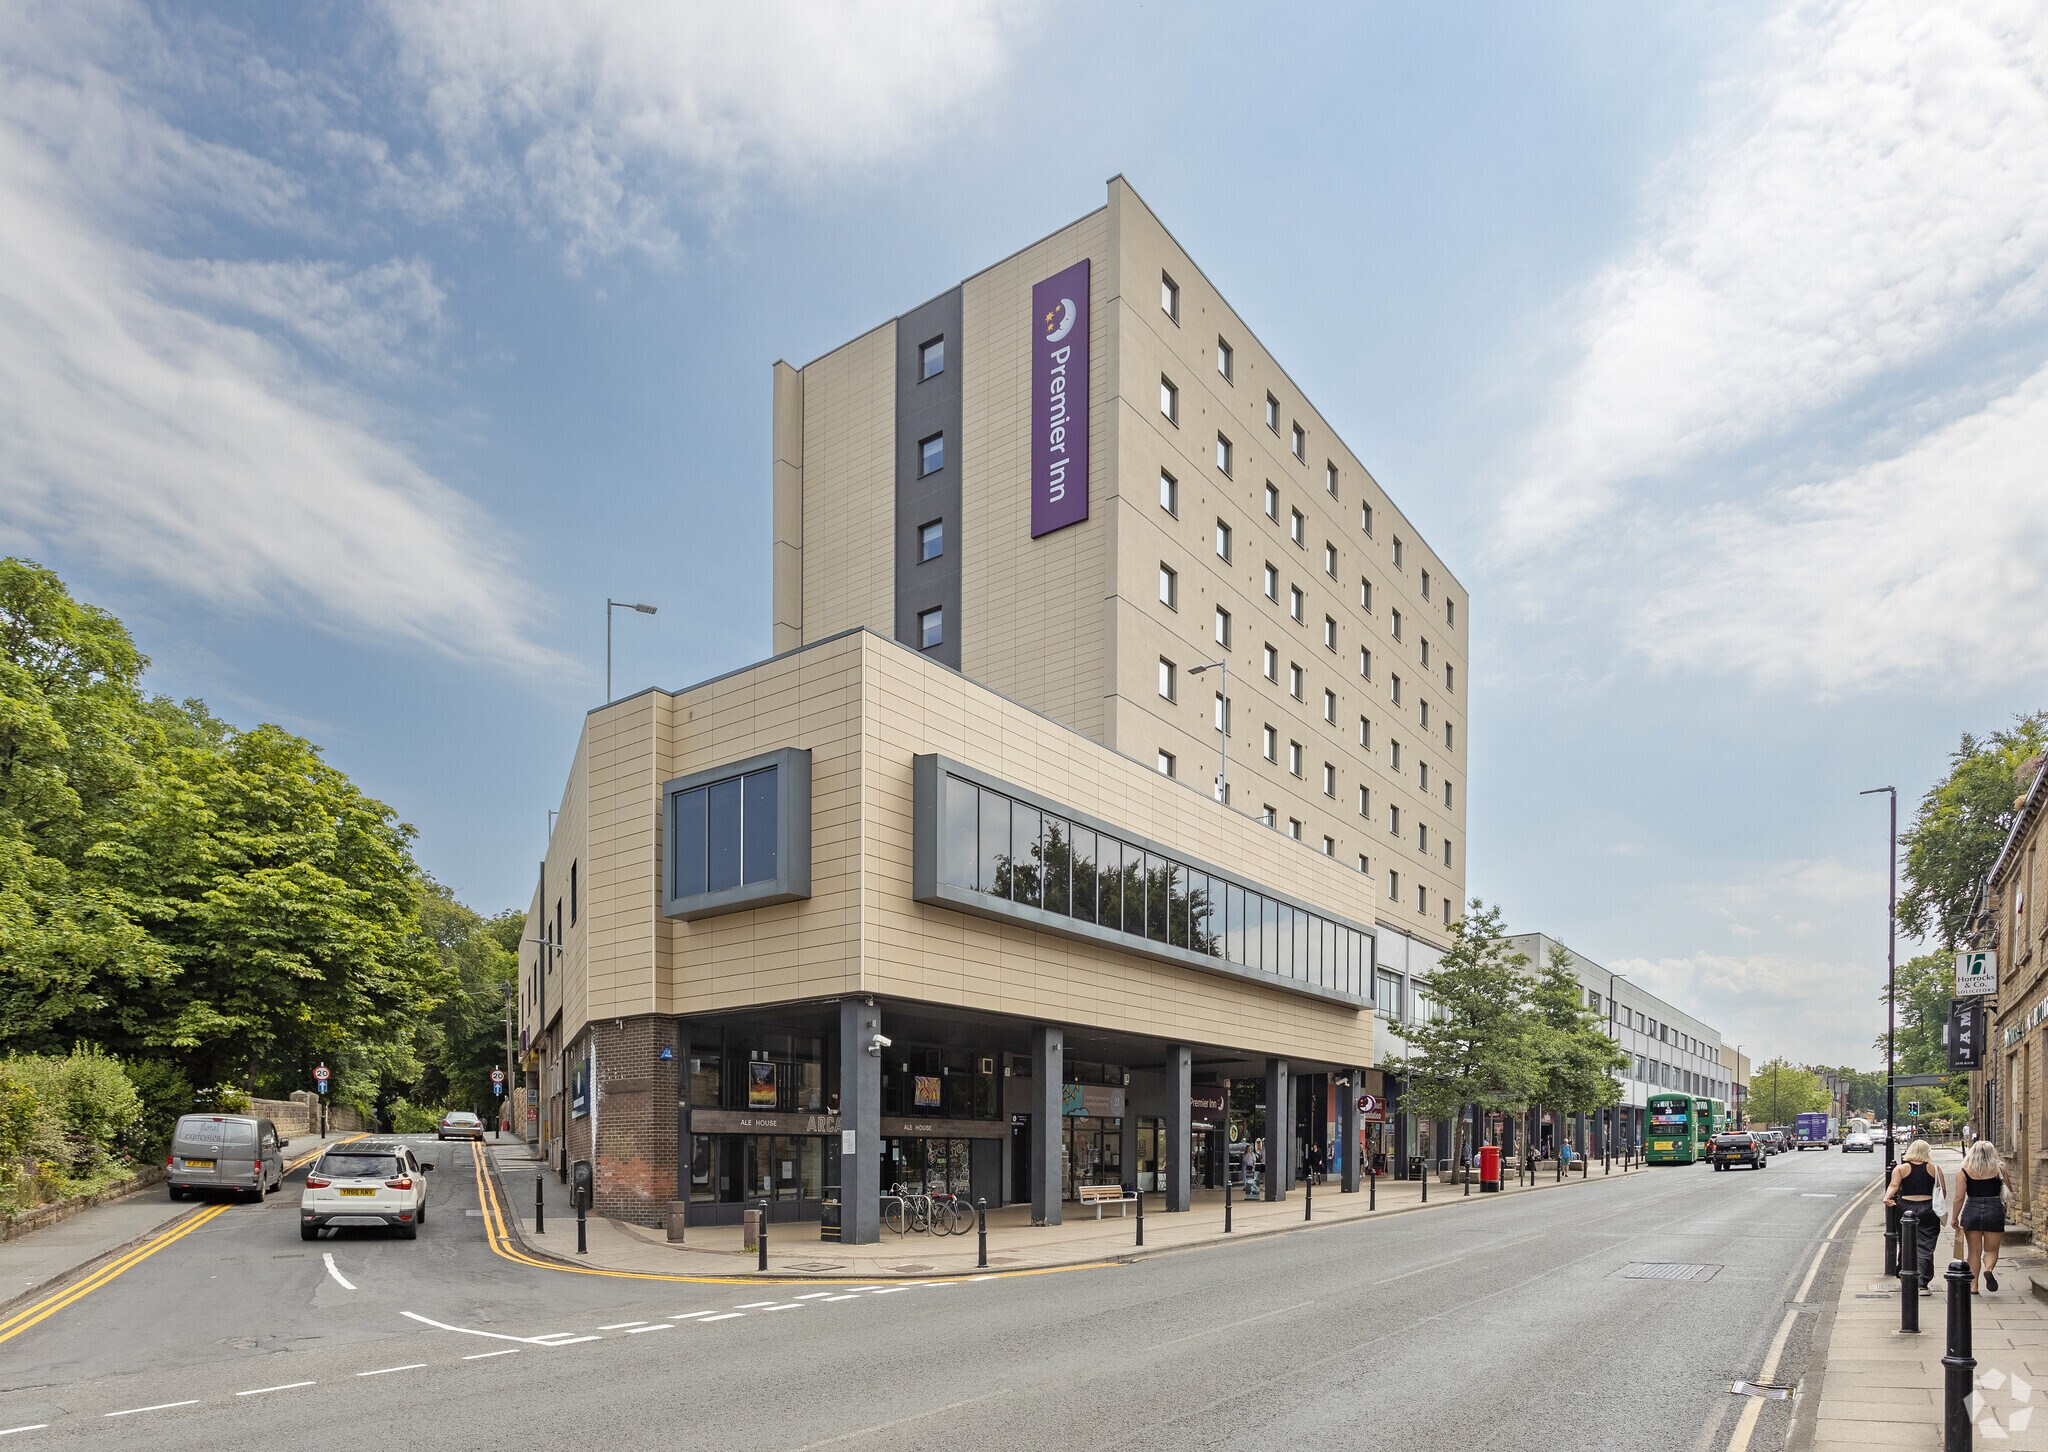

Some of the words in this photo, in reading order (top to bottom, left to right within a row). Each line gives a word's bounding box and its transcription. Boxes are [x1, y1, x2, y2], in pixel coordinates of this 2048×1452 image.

[1050, 345, 1070, 453] Premier
[1050, 457, 1070, 503] Inn
[1957, 974, 1995, 983] Horrocks
[1957, 987, 1995, 995] SOLICITORS
[1960, 1011, 1971, 1059] JAM
[1190, 1097, 1209, 1108] Premier
[1209, 1099, 1218, 1109] Inn
[201, 1122, 220, 1131] floral
[755, 1119, 777, 1127] HOUSE
[915, 1124, 932, 1132] HOUSE
[185, 1133, 222, 1142] expression
